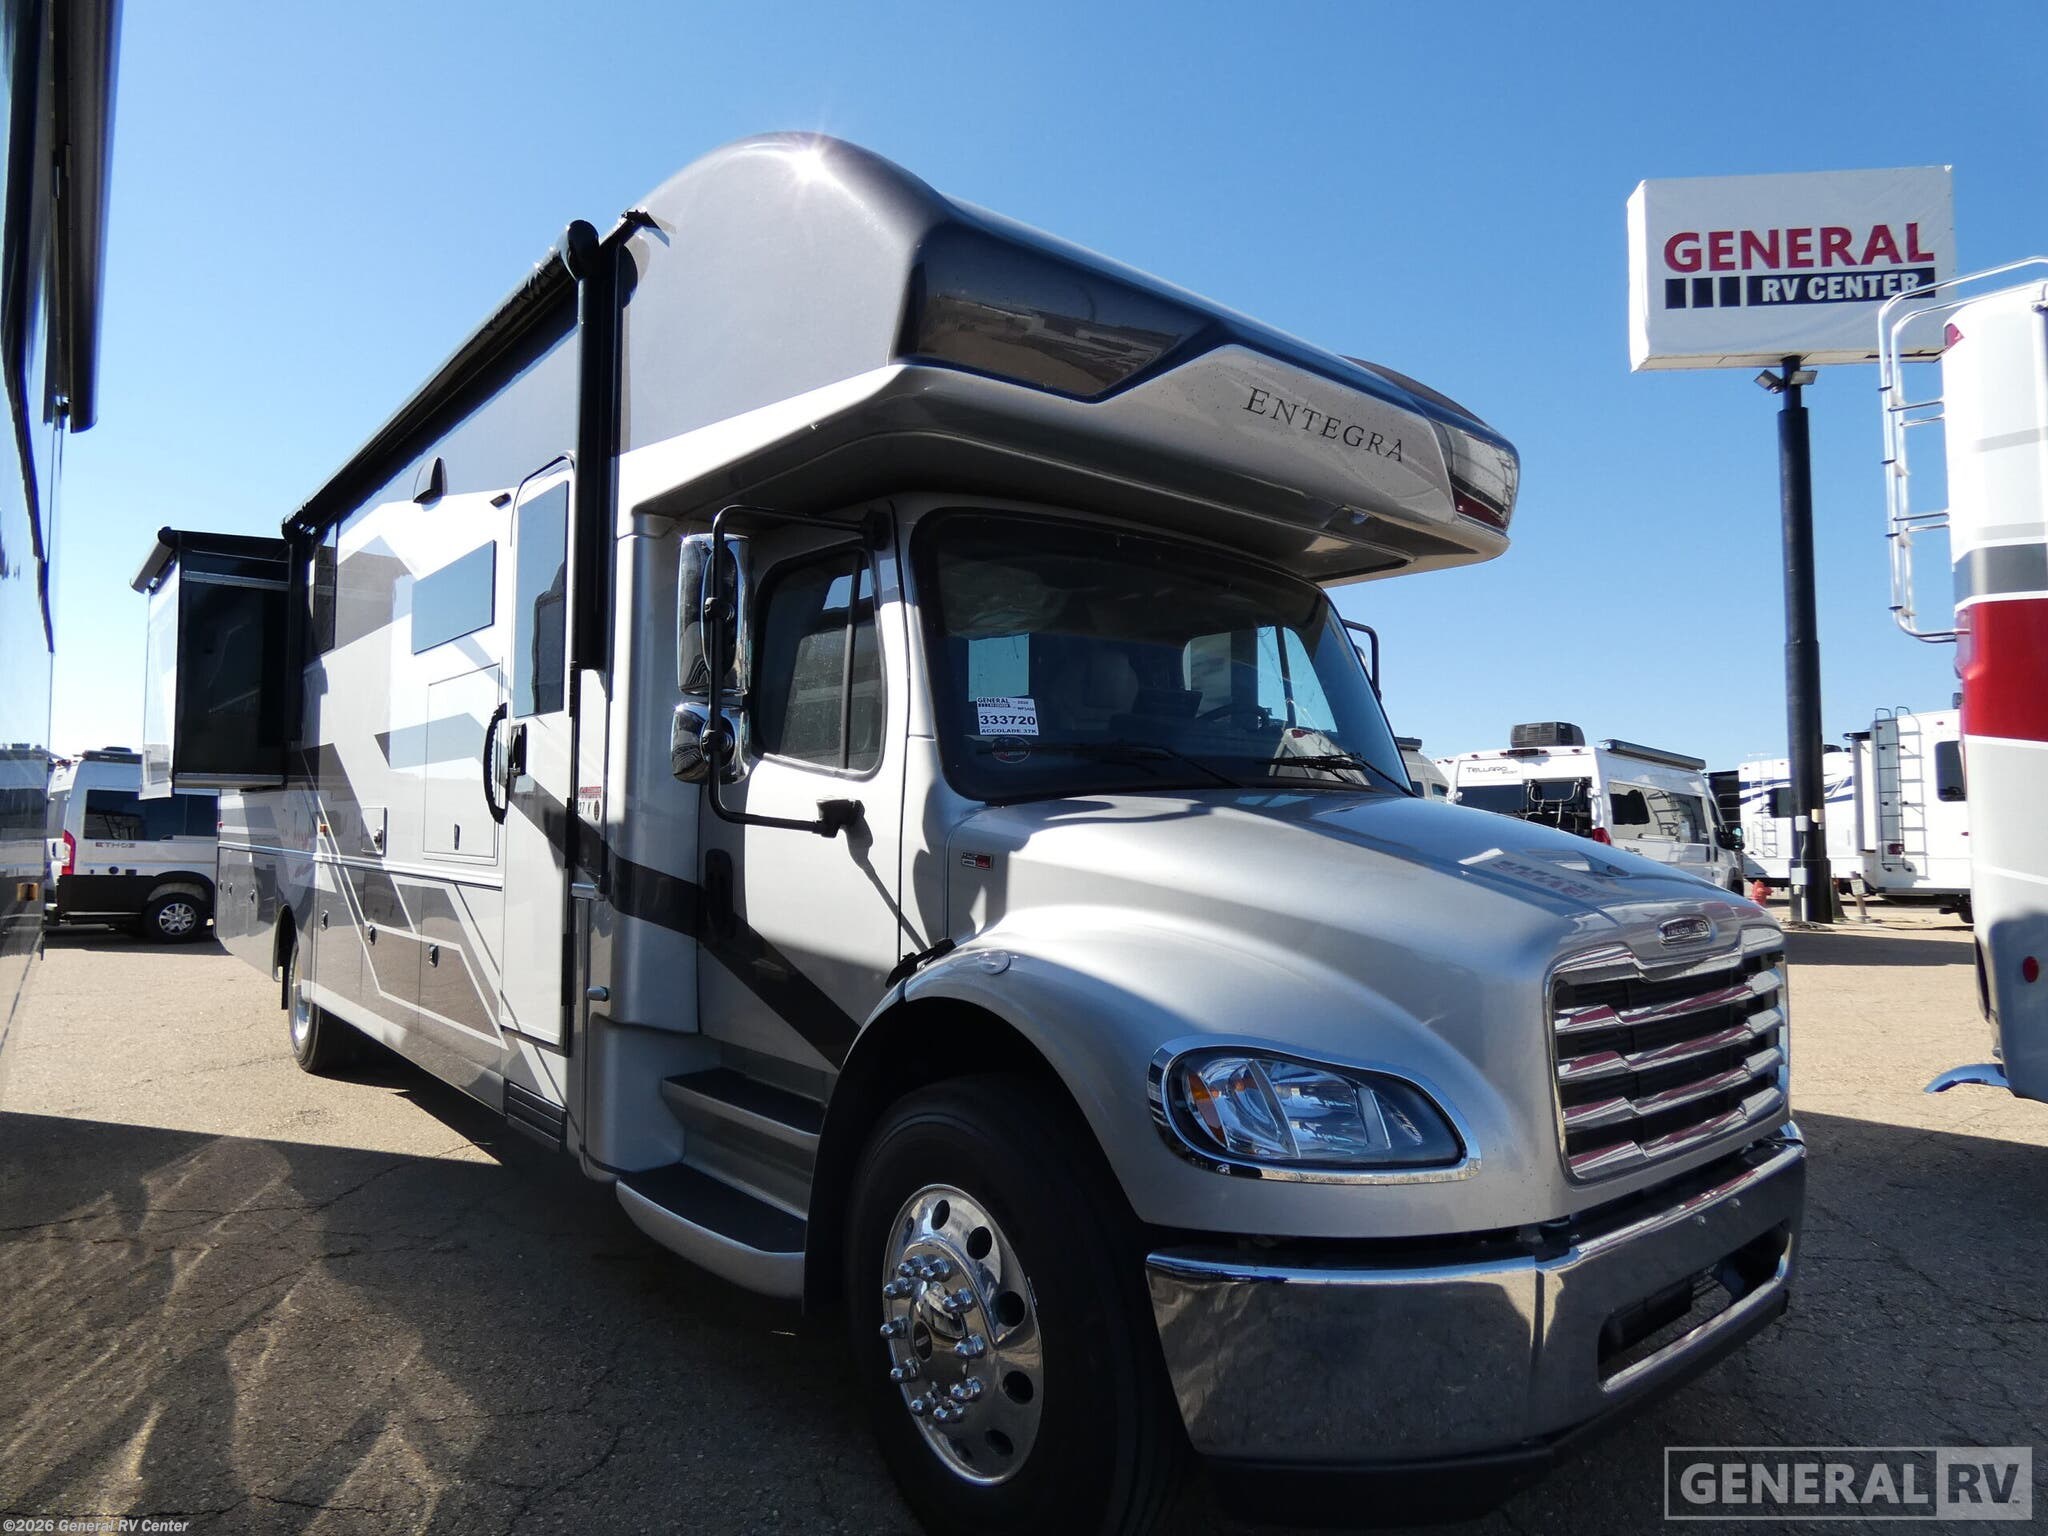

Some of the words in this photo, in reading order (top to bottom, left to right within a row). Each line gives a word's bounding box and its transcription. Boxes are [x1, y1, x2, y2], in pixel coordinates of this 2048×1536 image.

[1664, 222, 1935, 273] GENERAL
[1762, 277, 1797, 302] RV
[1808, 271, 1920, 300] CENTER
[1243, 386, 1404, 463] ENTEGRA
[980, 715, 1036, 725] 333720
